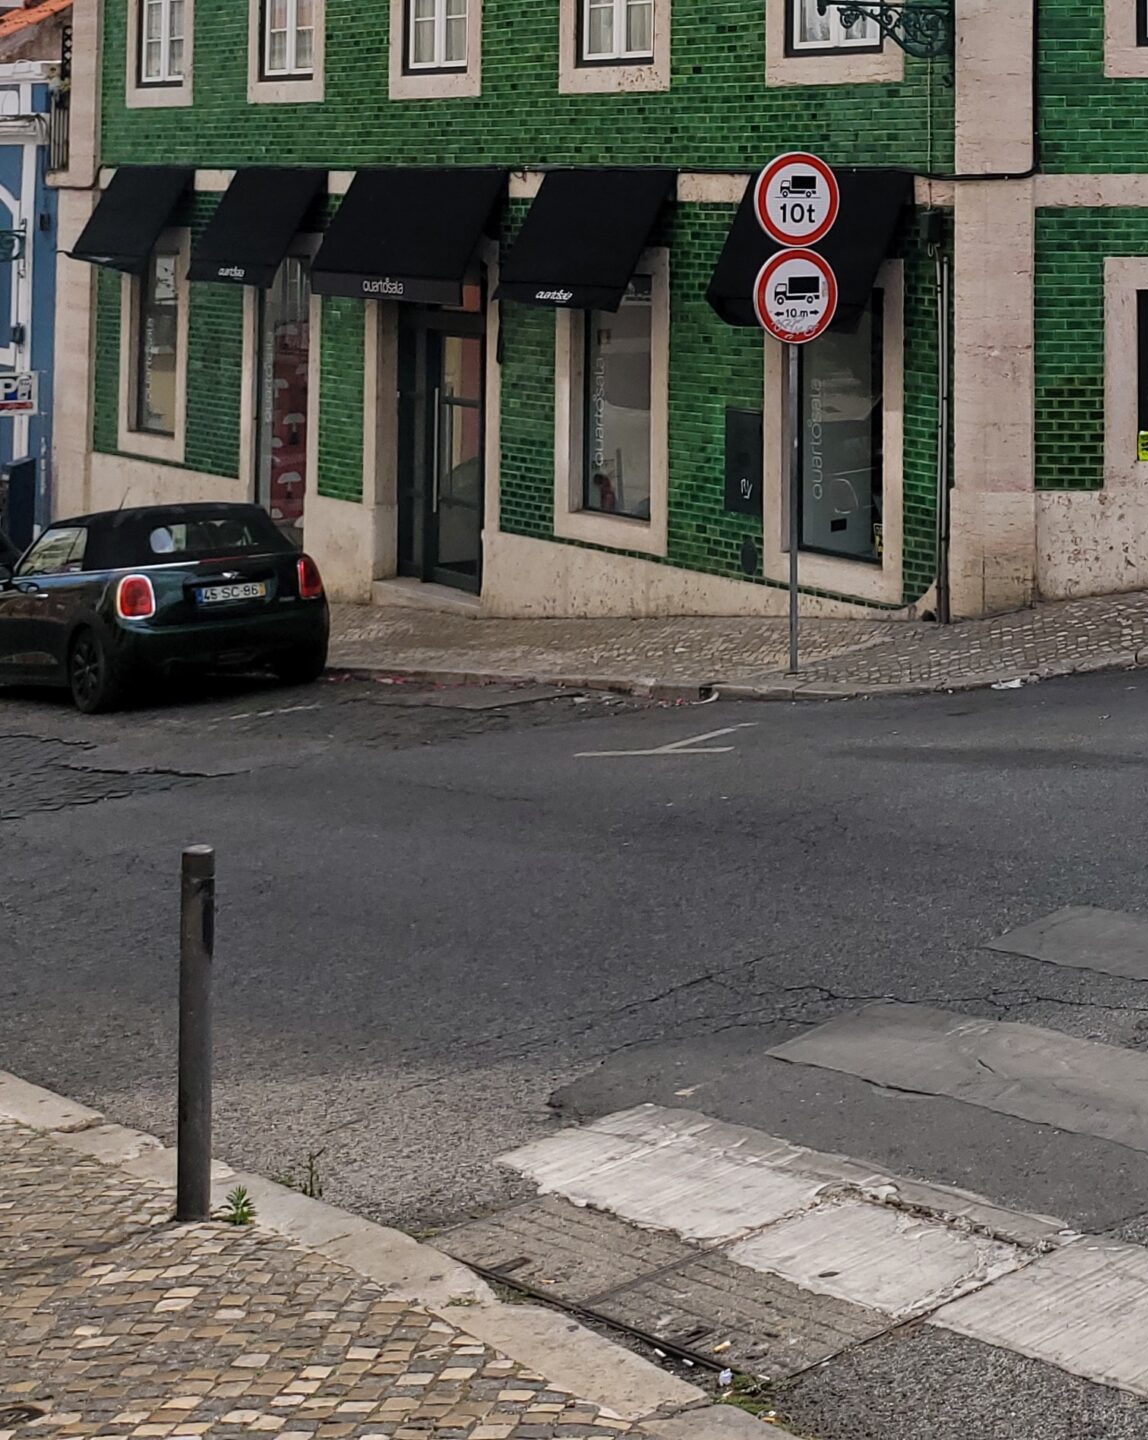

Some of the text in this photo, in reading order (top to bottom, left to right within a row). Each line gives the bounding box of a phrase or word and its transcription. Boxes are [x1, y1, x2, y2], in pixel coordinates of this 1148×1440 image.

[779, 203, 816, 224] 10t
[785, 307, 809, 318] 10 m
[807, 378, 824, 500] quartosala
[204, 585, 259, 601] 45-SC-96
